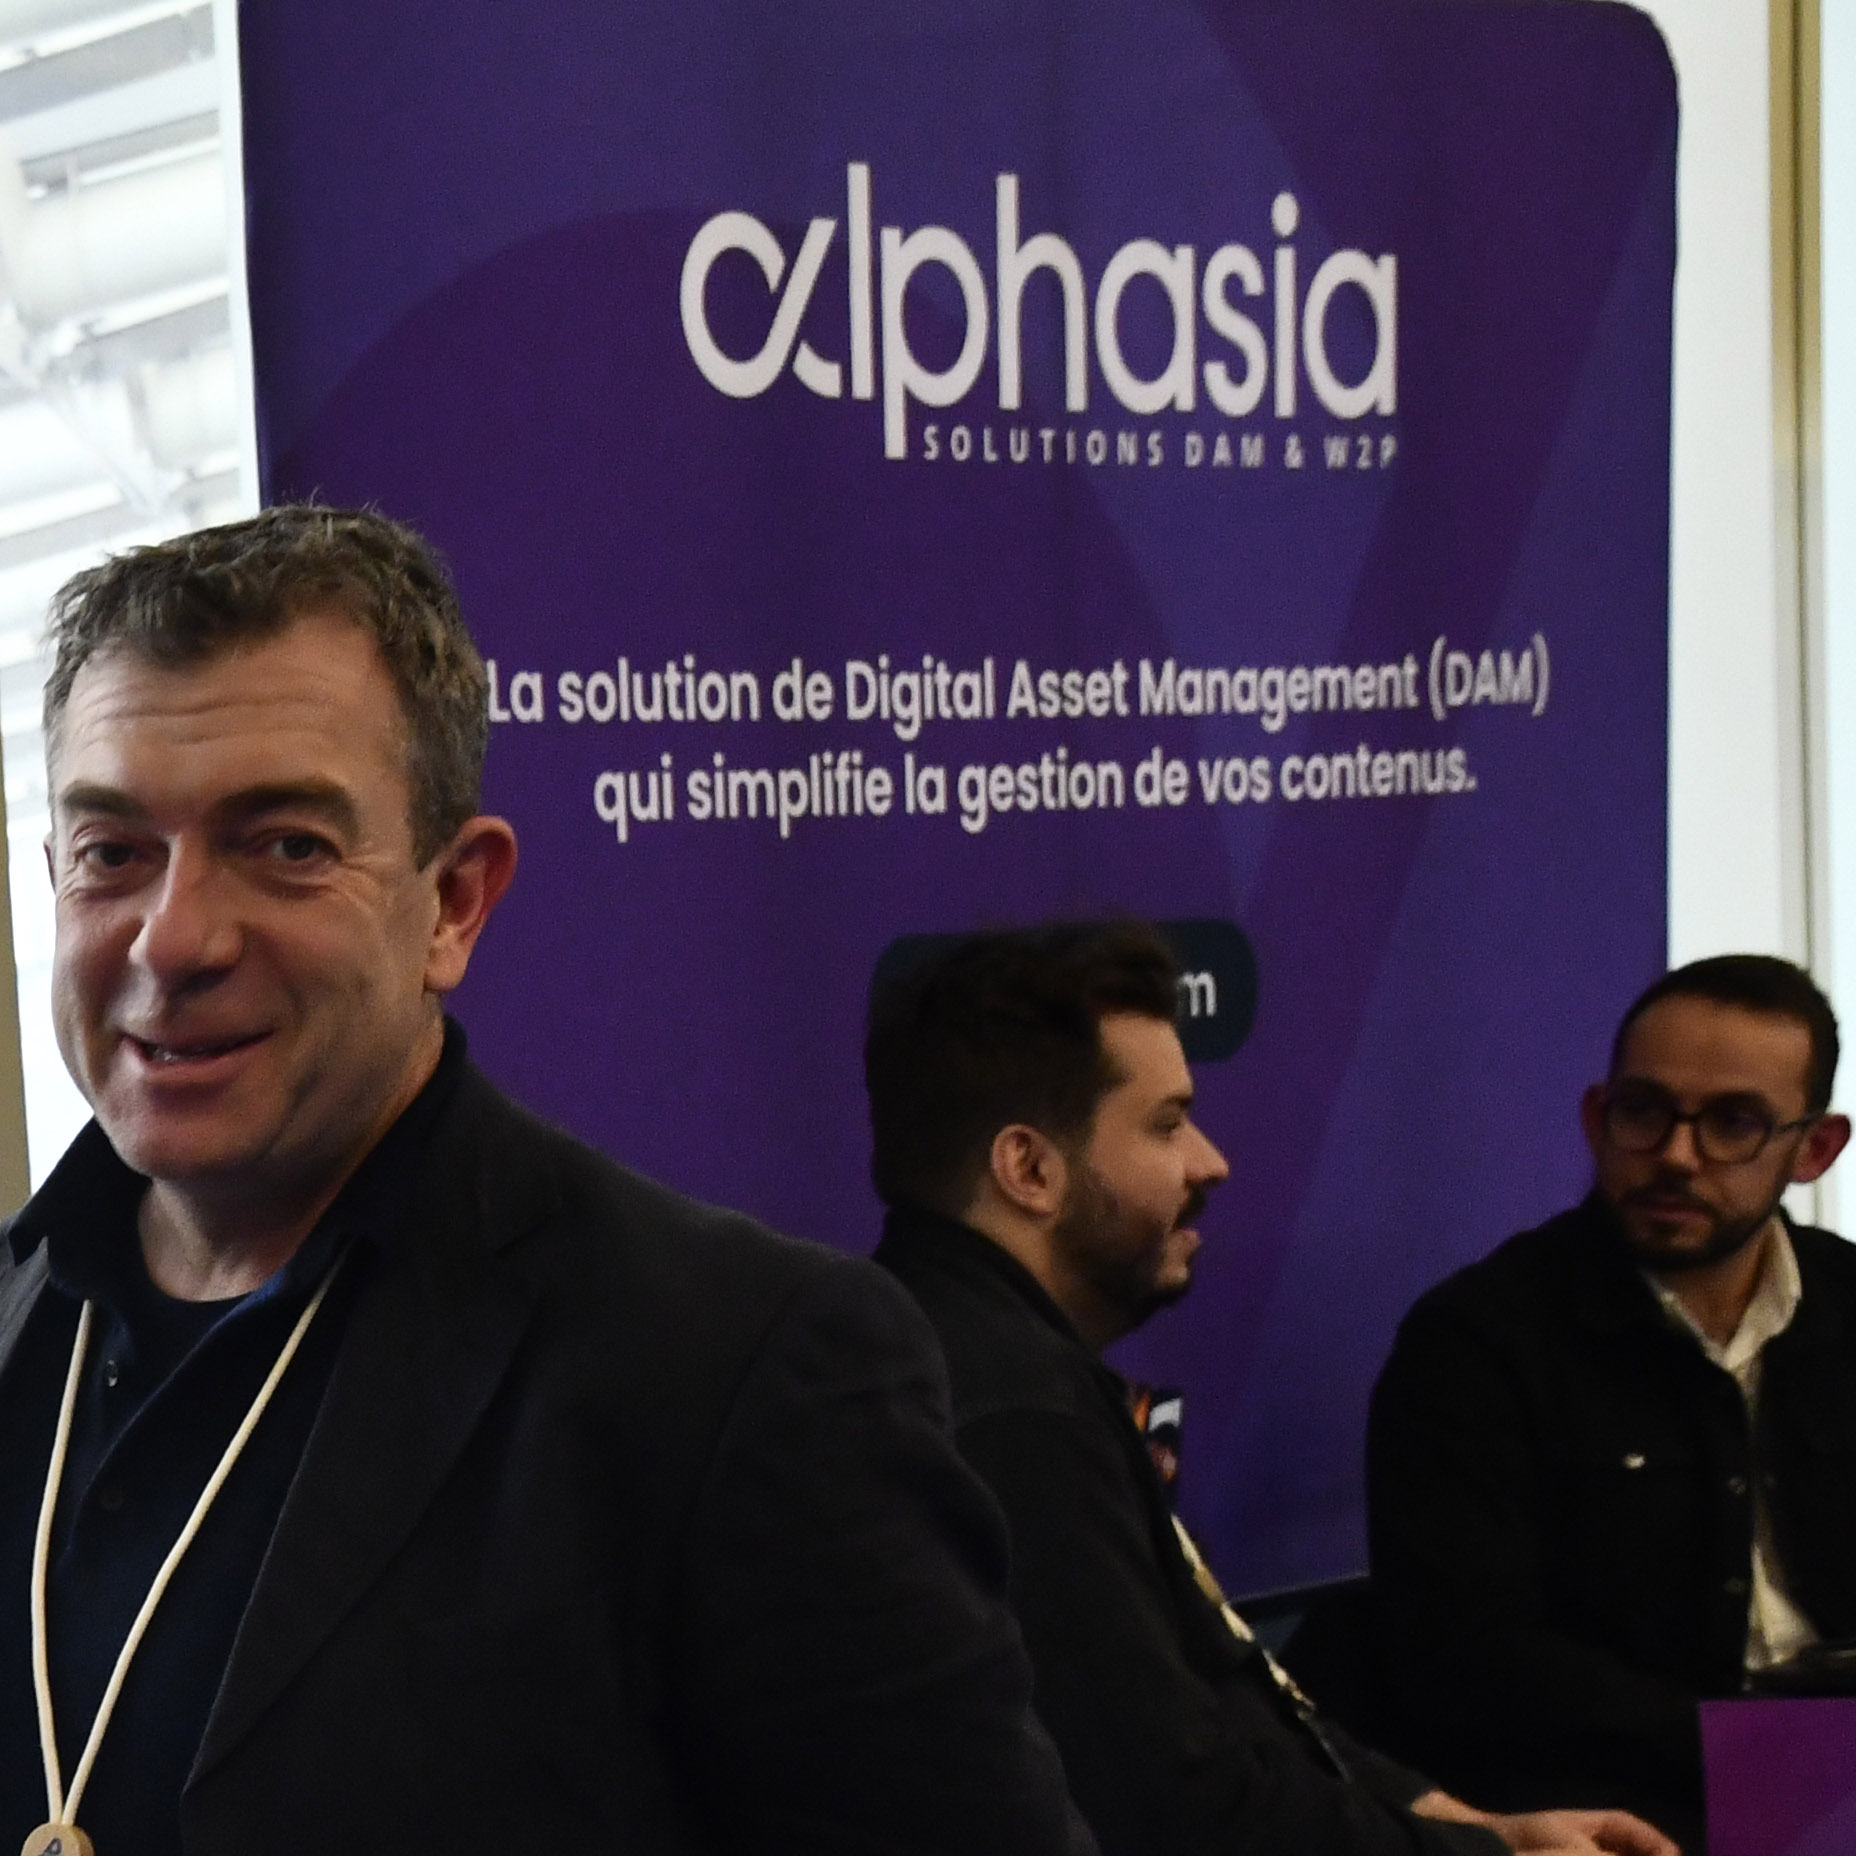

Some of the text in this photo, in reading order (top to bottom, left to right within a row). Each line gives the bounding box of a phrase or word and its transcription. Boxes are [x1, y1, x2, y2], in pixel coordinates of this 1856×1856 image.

[923, 424, 1397, 469] SOLUTIONS DAM & W2P
[486, 634, 1550, 742] La solution de Digital Asset Management (DAM)
[593, 744, 1477, 844] qui simplifie la gestion de vos contenus.
